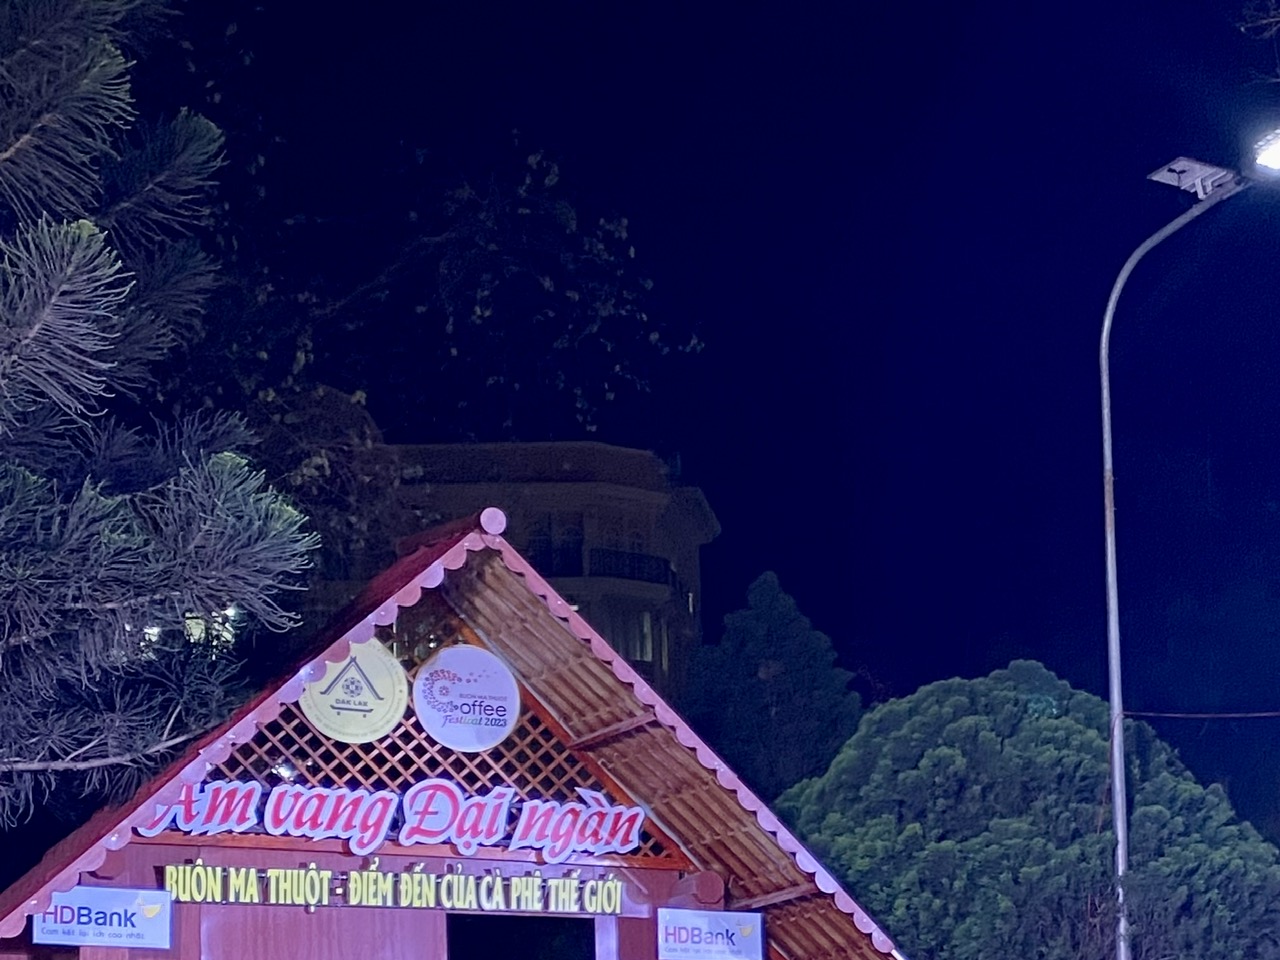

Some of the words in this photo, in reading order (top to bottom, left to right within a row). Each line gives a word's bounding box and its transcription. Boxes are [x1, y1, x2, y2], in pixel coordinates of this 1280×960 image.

[484, 717, 507, 727] 2023
[270, 787, 392, 850] vang
[404, 782, 508, 850] Đại
[517, 794, 641, 859] ngàn
[165, 858, 222, 903] BUÔN
[228, 867, 259, 903] MA
[267, 862, 332, 912] THUỘT
[350, 857, 394, 907] ĐIỂM
[400, 862, 436, 908] ĐẾN
[440, 864, 478, 911] CỦA
[479, 866, 506, 911] CÀ
[511, 870, 543, 912] PHÊ
[548, 868, 580, 913] THẾ
[583, 873, 623, 915] GIỚI
[42, 904, 137, 929] HDBank
[664, 926, 736, 946] HDBank
